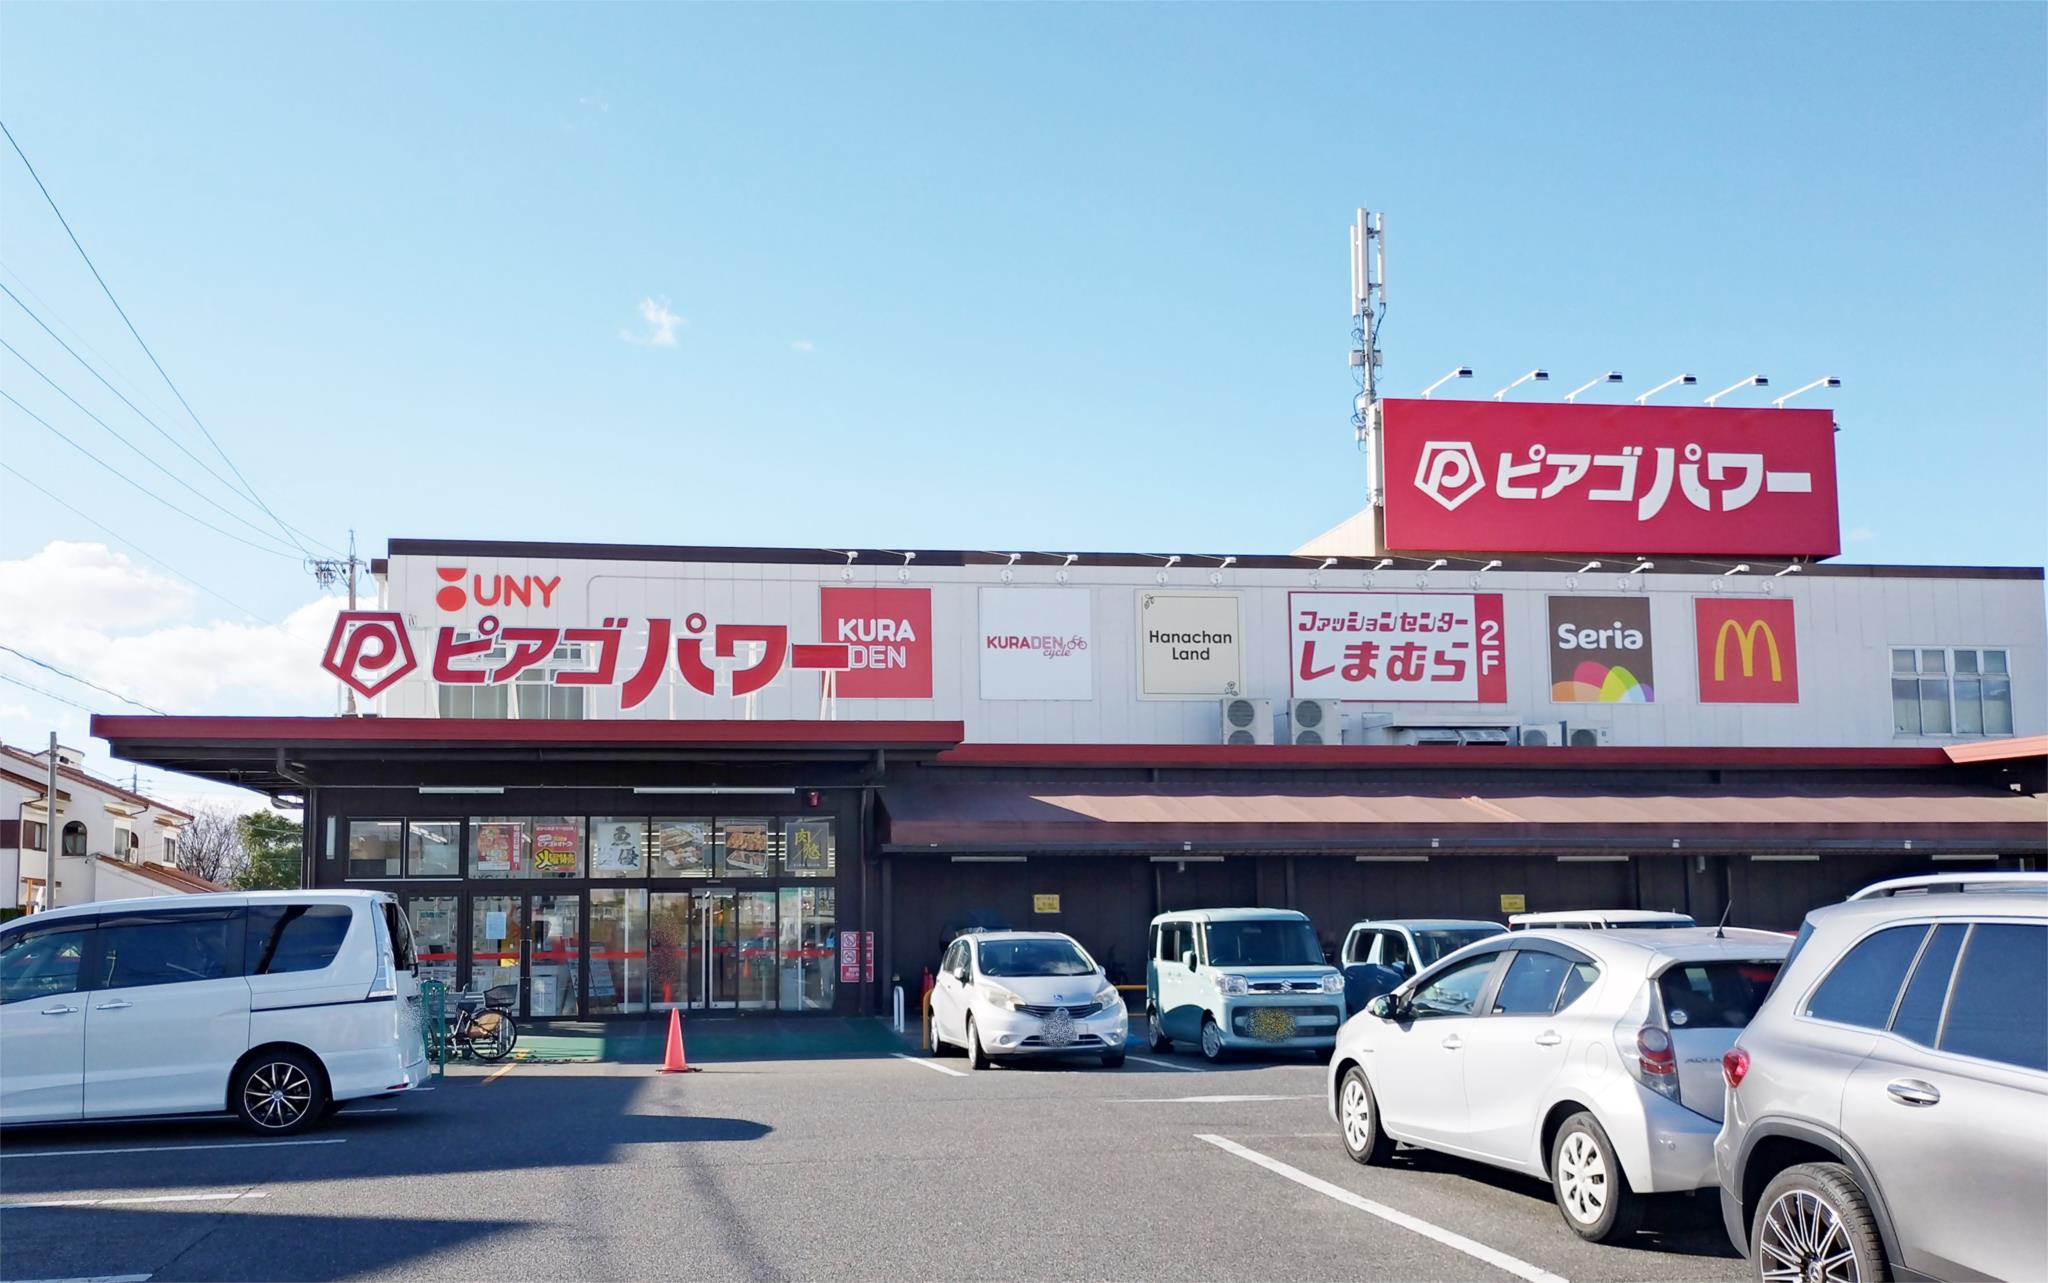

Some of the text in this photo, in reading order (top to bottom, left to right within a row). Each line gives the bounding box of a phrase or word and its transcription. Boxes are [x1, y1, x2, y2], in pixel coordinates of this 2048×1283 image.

[1496, 443, 1812, 521] ピアゴパワー
[474, 575, 560, 608] UNY
[838, 618, 916, 642] KURA
[1299, 611, 1468, 633] ファッションセンター
[987, 635, 1063, 649] KURADEN
[1149, 629, 1232, 646] Hanachan
[1558, 621, 1644, 651] Seria
[432, 612, 850, 710] ピアゴパワー
[850, 645, 906, 669] DEN
[1043, 644, 1071, 660] cycle
[1172, 646, 1210, 662] Land
[1299, 640, 1469, 683] しまむら
